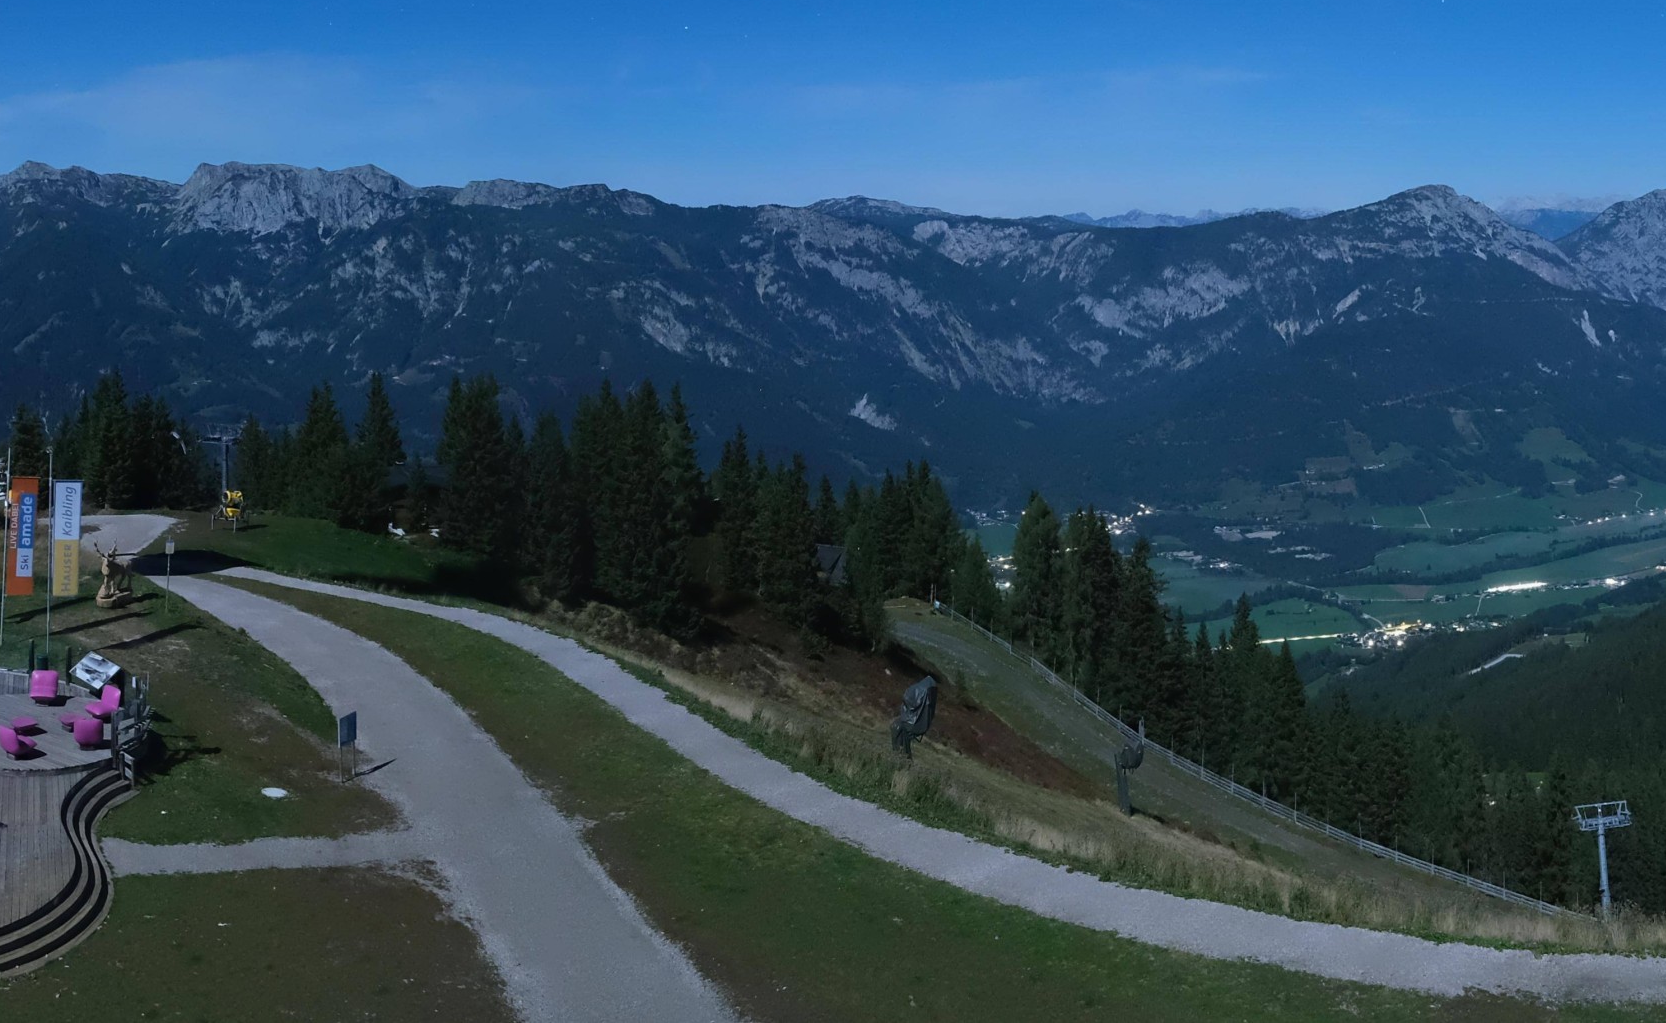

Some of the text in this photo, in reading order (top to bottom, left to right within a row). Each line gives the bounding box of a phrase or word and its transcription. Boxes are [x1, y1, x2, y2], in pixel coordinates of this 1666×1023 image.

[11, 503, 19, 528] DABEI
[20, 496, 33, 570] Ski amade
[61, 486, 77, 592] HAUSER Kaibling
